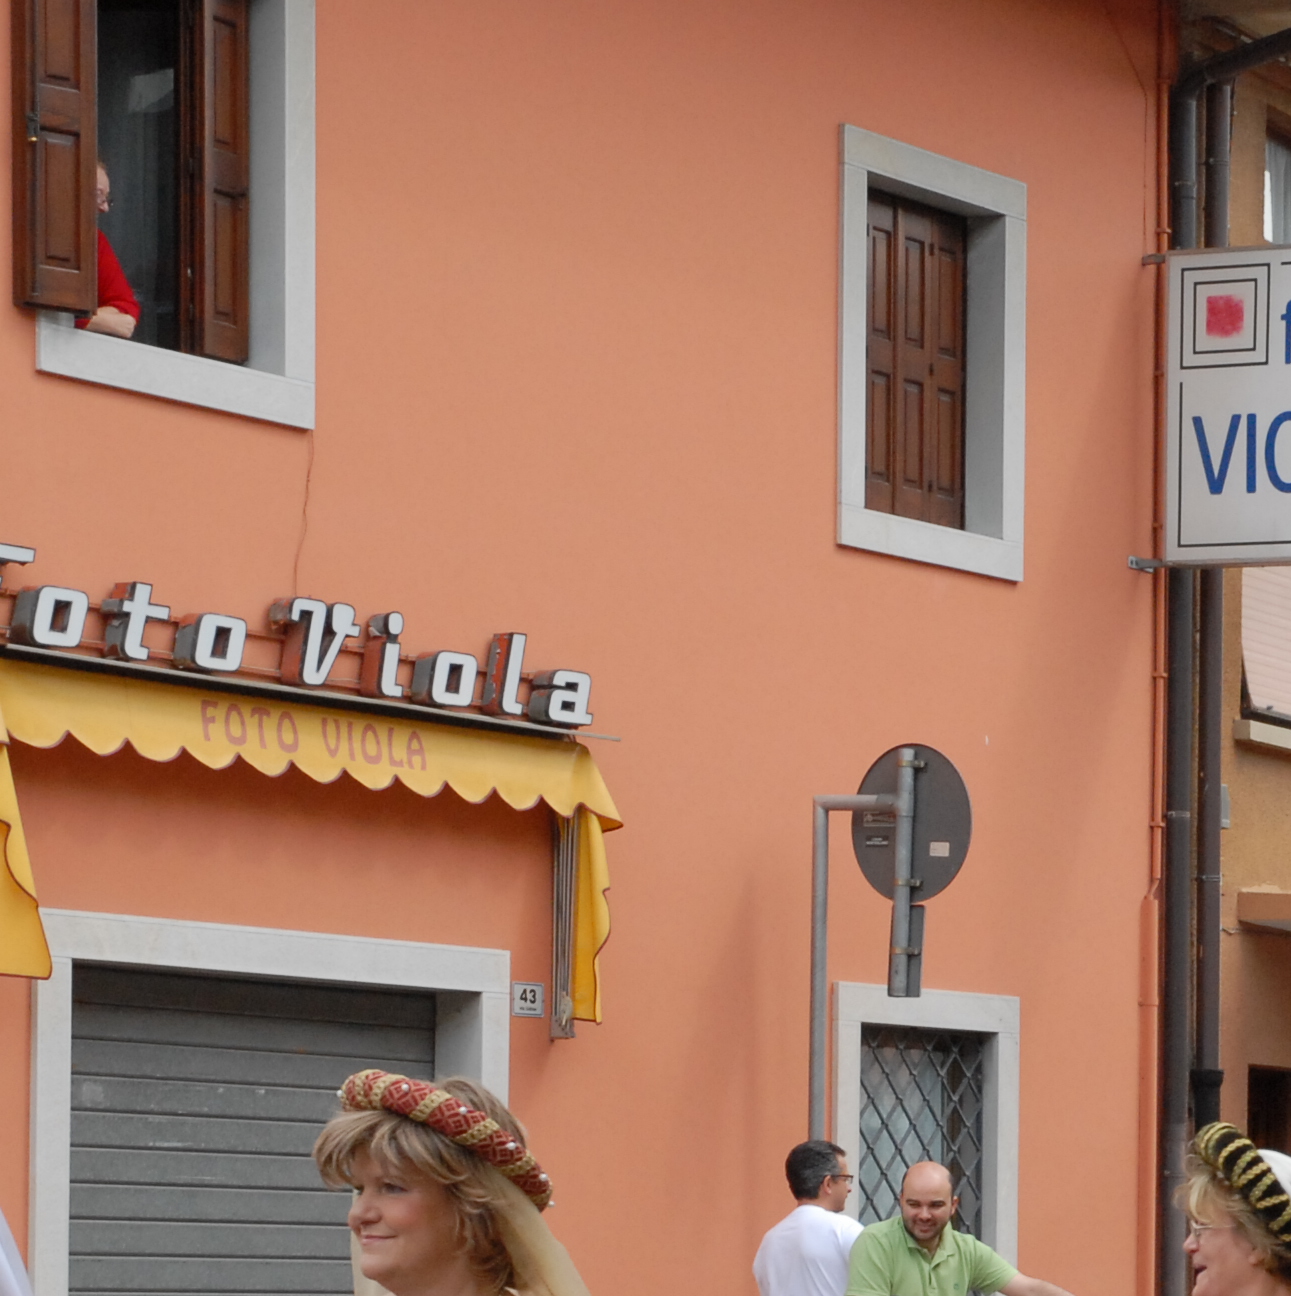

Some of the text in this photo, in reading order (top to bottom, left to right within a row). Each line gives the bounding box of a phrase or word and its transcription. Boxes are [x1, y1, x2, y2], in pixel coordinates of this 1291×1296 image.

[290, 596, 594, 726] Viola
[200, 699, 428, 772] FOTO VIOLA
[519, 987, 538, 1005] 43
